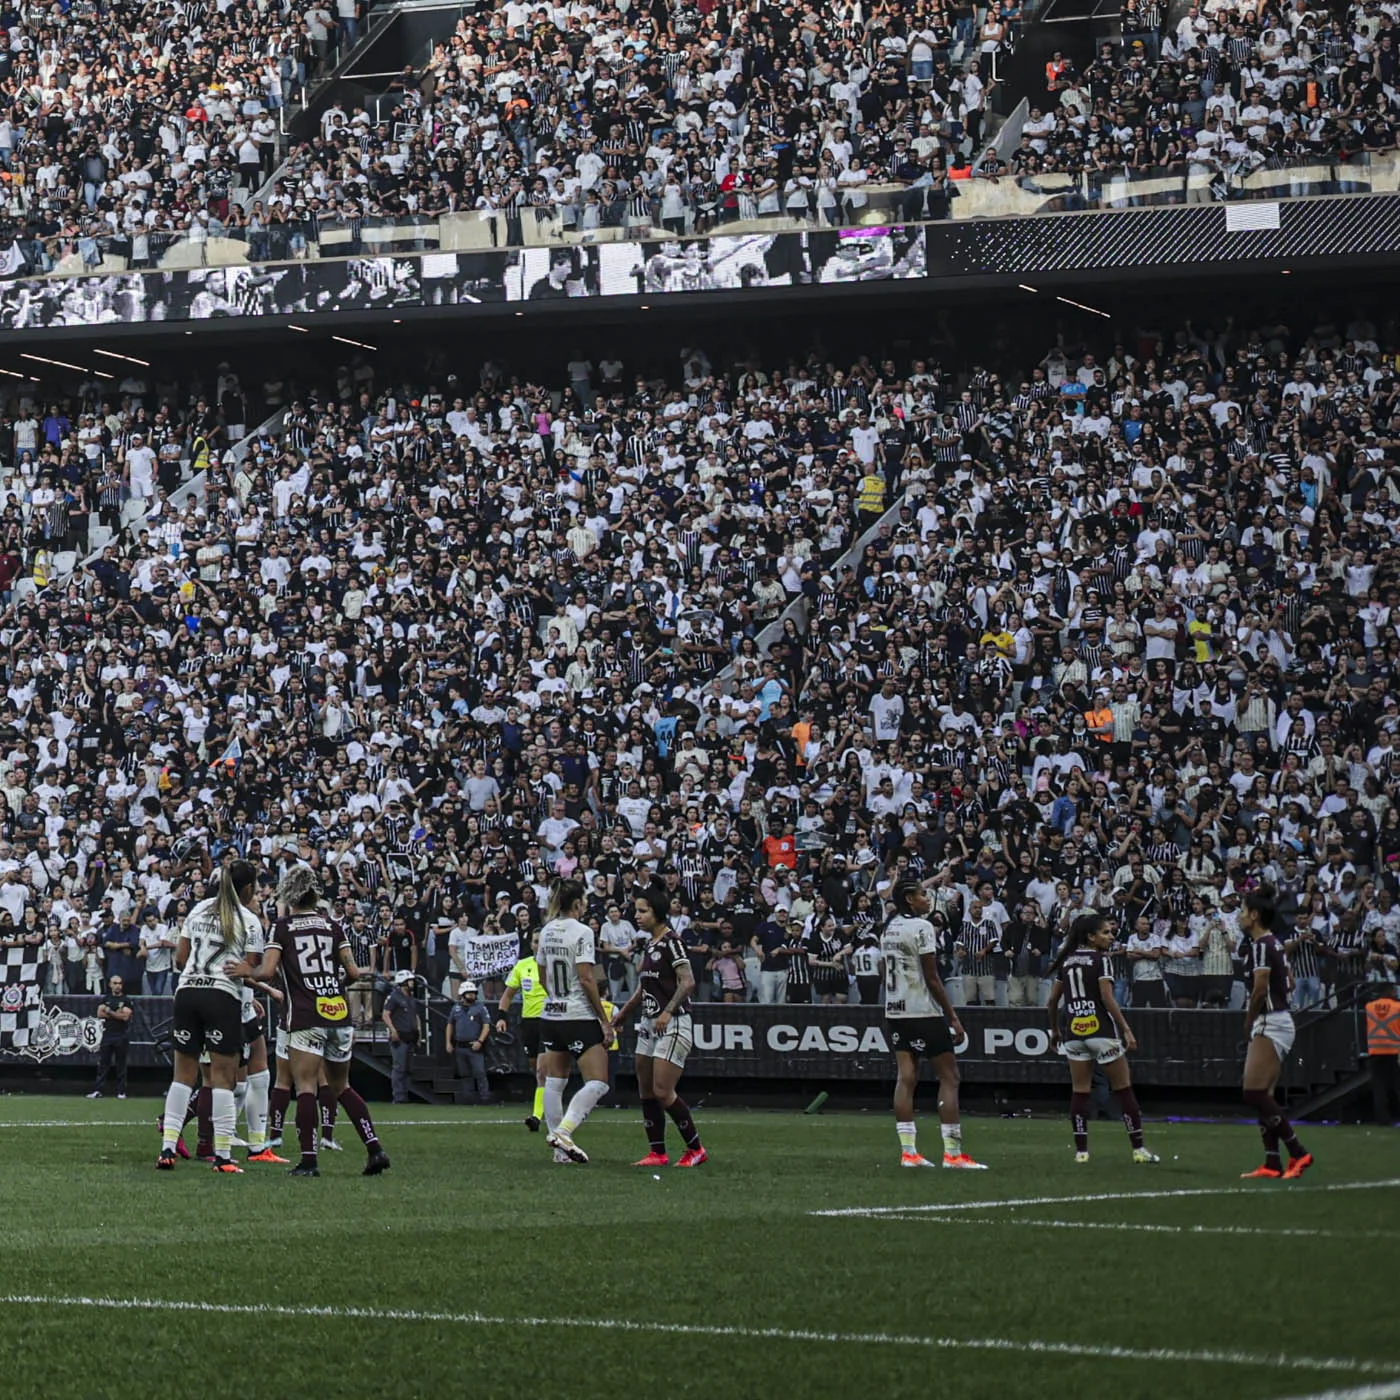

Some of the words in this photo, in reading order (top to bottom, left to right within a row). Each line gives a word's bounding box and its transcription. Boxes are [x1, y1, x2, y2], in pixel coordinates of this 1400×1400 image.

[295, 935, 334, 974] 22
[856, 954, 871, 972] 16
[1068, 967, 1086, 998] 11
[766, 1024, 891, 1053] CASA
